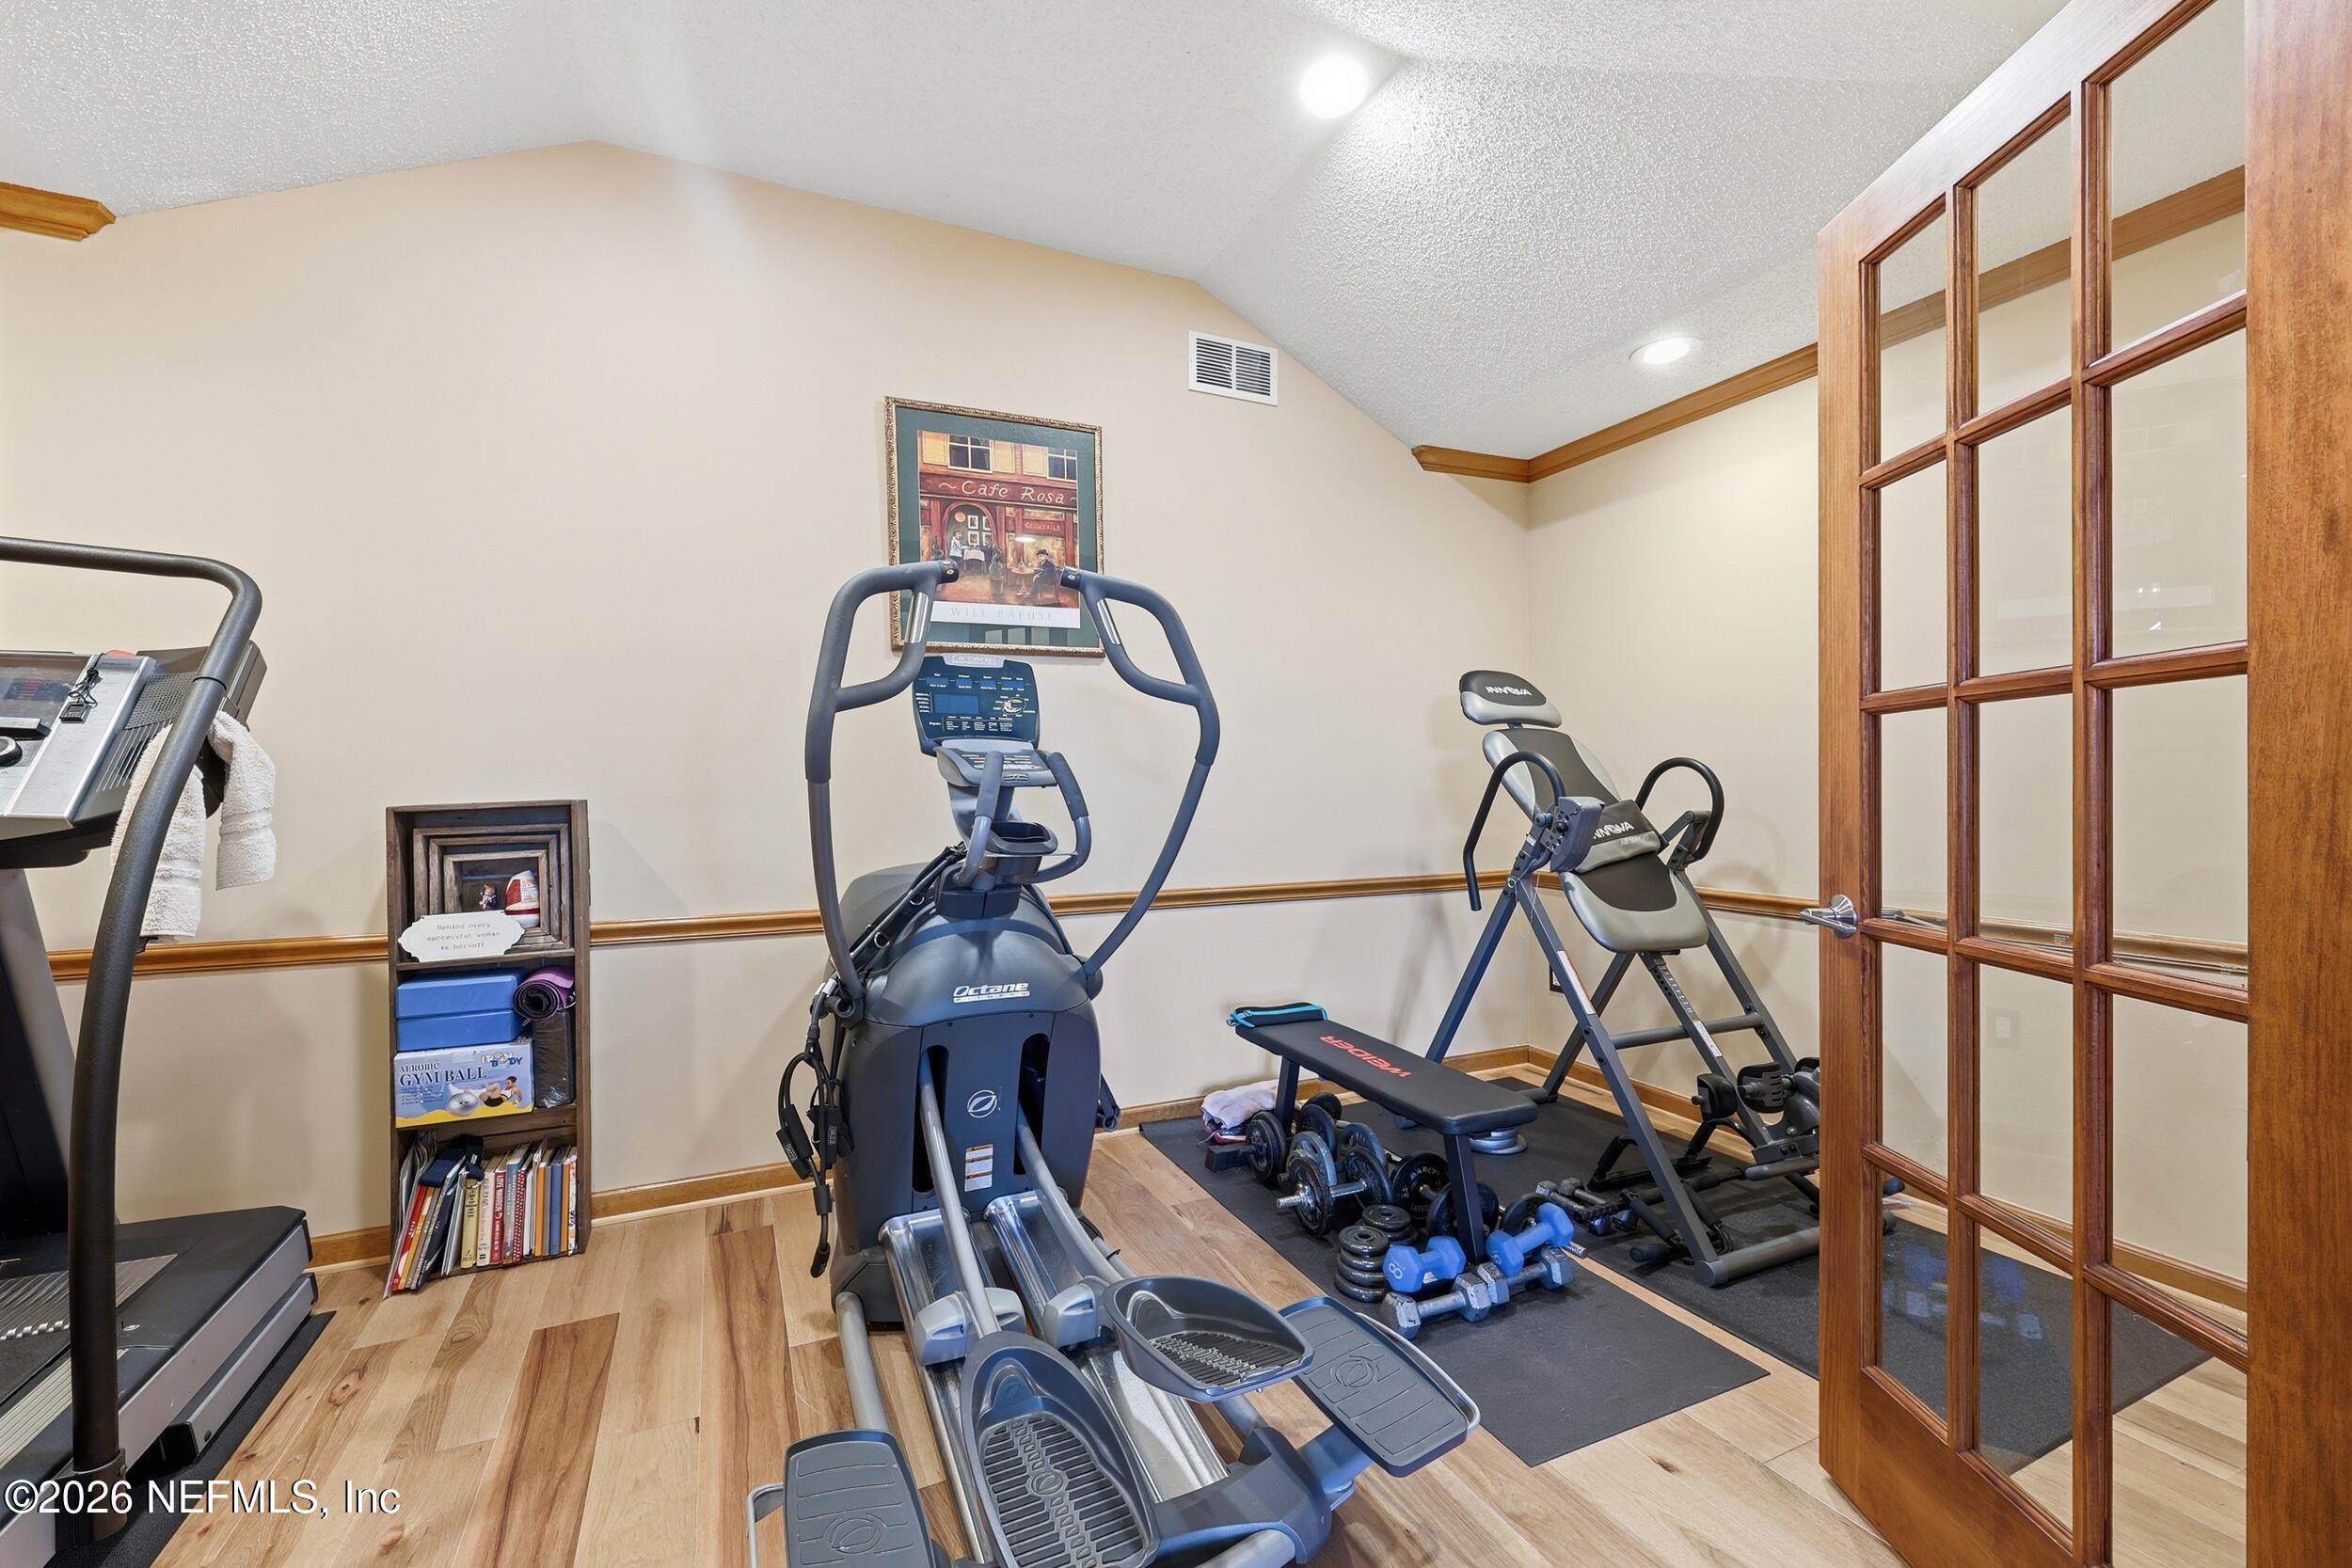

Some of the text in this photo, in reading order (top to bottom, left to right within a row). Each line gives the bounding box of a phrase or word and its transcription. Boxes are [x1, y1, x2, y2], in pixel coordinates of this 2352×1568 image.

[961, 480, 1065, 505] Cafe Rosa
[950, 607, 987, 618] WILL
[1593, 821, 1635, 840] NNOVA
[953, 983, 1028, 996] Octane
[1320, 1036, 1411, 1078] WEIDER
[400, 1063, 440, 1072] AEROBIC
[400, 1068, 487, 1086] GYM BALL
[1389, 1262, 1403, 1279] 8
